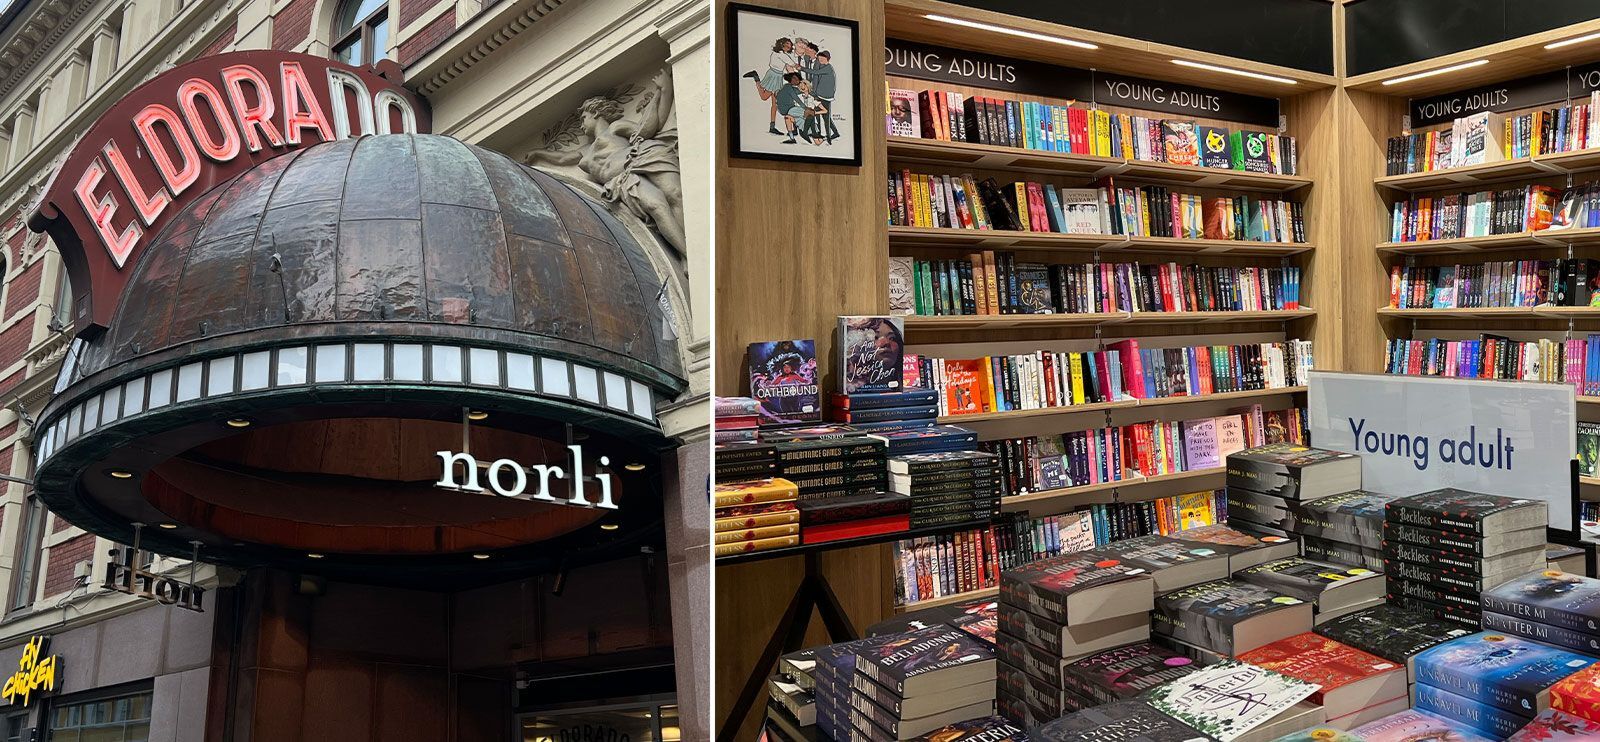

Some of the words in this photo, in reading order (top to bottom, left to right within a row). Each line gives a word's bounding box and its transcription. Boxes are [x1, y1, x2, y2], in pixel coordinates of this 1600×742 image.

[948, 57, 1016, 84] ADULTS
[1105, 80, 1166, 105] YOUNG
[1169, 90, 1222, 112] ADULTS
[1418, 98, 1462, 120] YOUNG
[1464, 88, 1509, 111] ADULTS
[74, 61, 417, 269] ELDORADO
[859, 347, 879, 363] Not
[860, 340, 876, 352] Am
[847, 361, 884, 382] Jessica
[869, 367, 896, 384] Chen
[757, 385, 818, 399] OATHBOUND
[1222, 420, 1238, 428] GIRL
[823, 448, 842, 457] GAMES
[1348, 417, 1429, 471] Young
[1438, 426, 1514, 470] adult
[436, 445, 618, 509] norli
[824, 462, 844, 472] GAMES
[825, 477, 844, 486] GAMES
[1399, 507, 1432, 526] Reckless
[1397, 525, 1430, 545] Reckless
[1397, 544, 1429, 564] Reckless
[1398, 564, 1431, 583] Reckless
[1402, 581, 1436, 601] Reckless
[880, 631, 961, 667] BELLADONNA
[2, 654, 56, 708] CHICKEN
[1418, 665, 1464, 690] UNRAVEL
[1418, 690, 1463, 716] UNRAVEL
[1486, 686, 1518, 702] TAHEREH
[1486, 714, 1518, 729] TAHEREH
